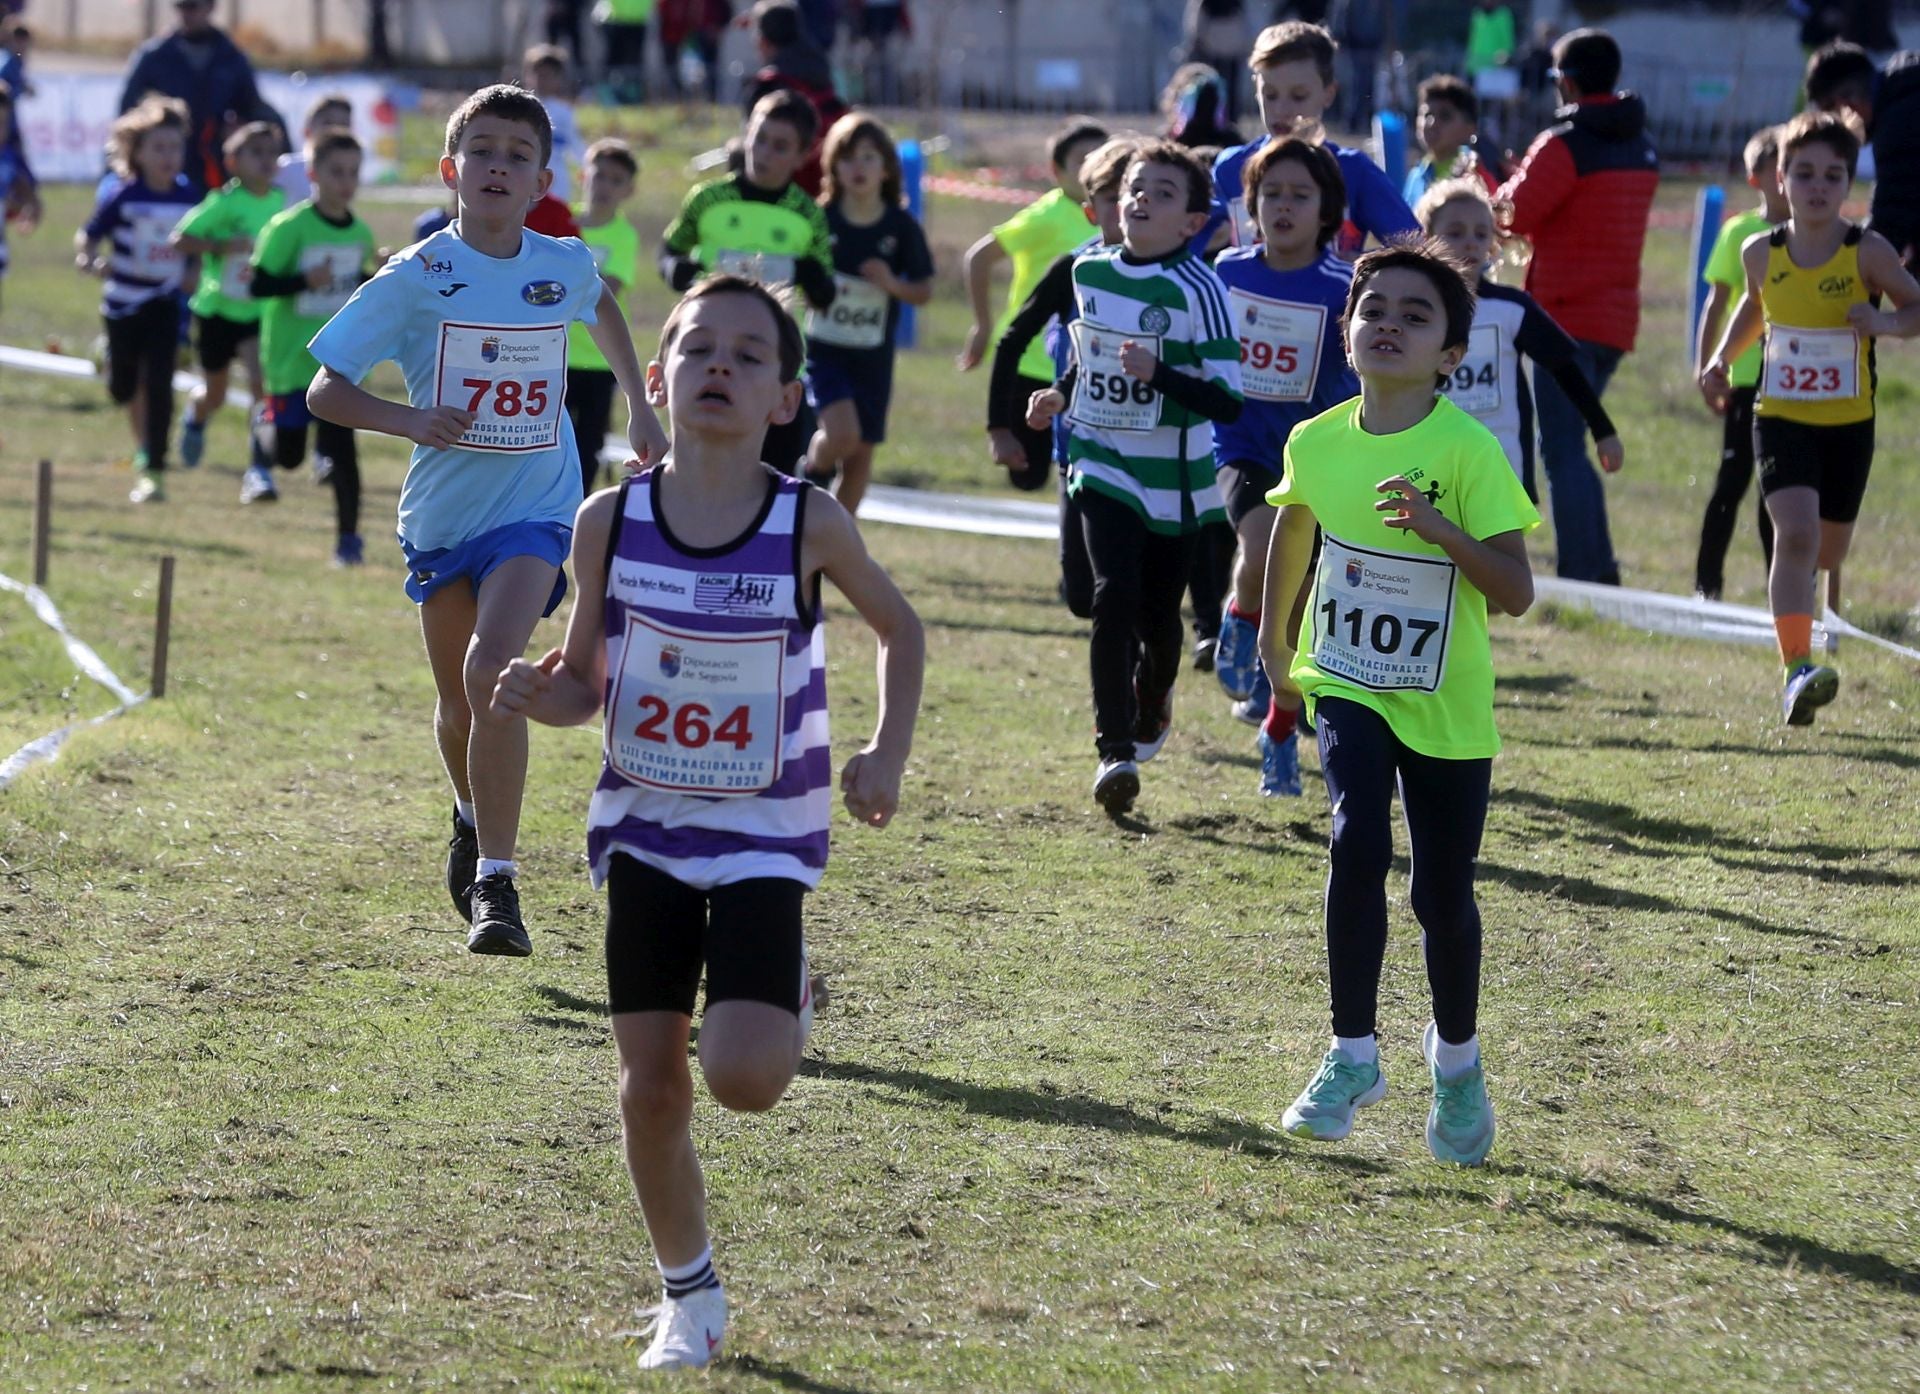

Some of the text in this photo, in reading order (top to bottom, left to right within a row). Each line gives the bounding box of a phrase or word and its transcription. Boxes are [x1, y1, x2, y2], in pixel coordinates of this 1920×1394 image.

[500, 343, 541, 353] Diputación
[499, 354, 540, 365] de Segovia
[1779, 364, 1841, 392] 323
[462, 377, 548, 418] 785
[500, 422, 541, 433] NACIONAL
[1364, 568, 1411, 585] Diputación
[1362, 581, 1410, 596] de Segovia
[1321, 598, 1440, 657] 1107
[682, 655, 739, 669] Diputación
[1319, 653, 1425, 685] CANTIMPALOS 2025
[1359, 658, 1412, 674] NACIONAL
[1414, 665, 1429, 674] DE
[681, 669, 738, 684] de Segovia
[634, 694, 753, 750] 264
[641, 752, 678, 768] CROSS
[680, 759, 746, 772] NACIONAL
[748, 761, 765, 772] DE
[621, 758, 760, 787] CANTIMPALOS 2025
